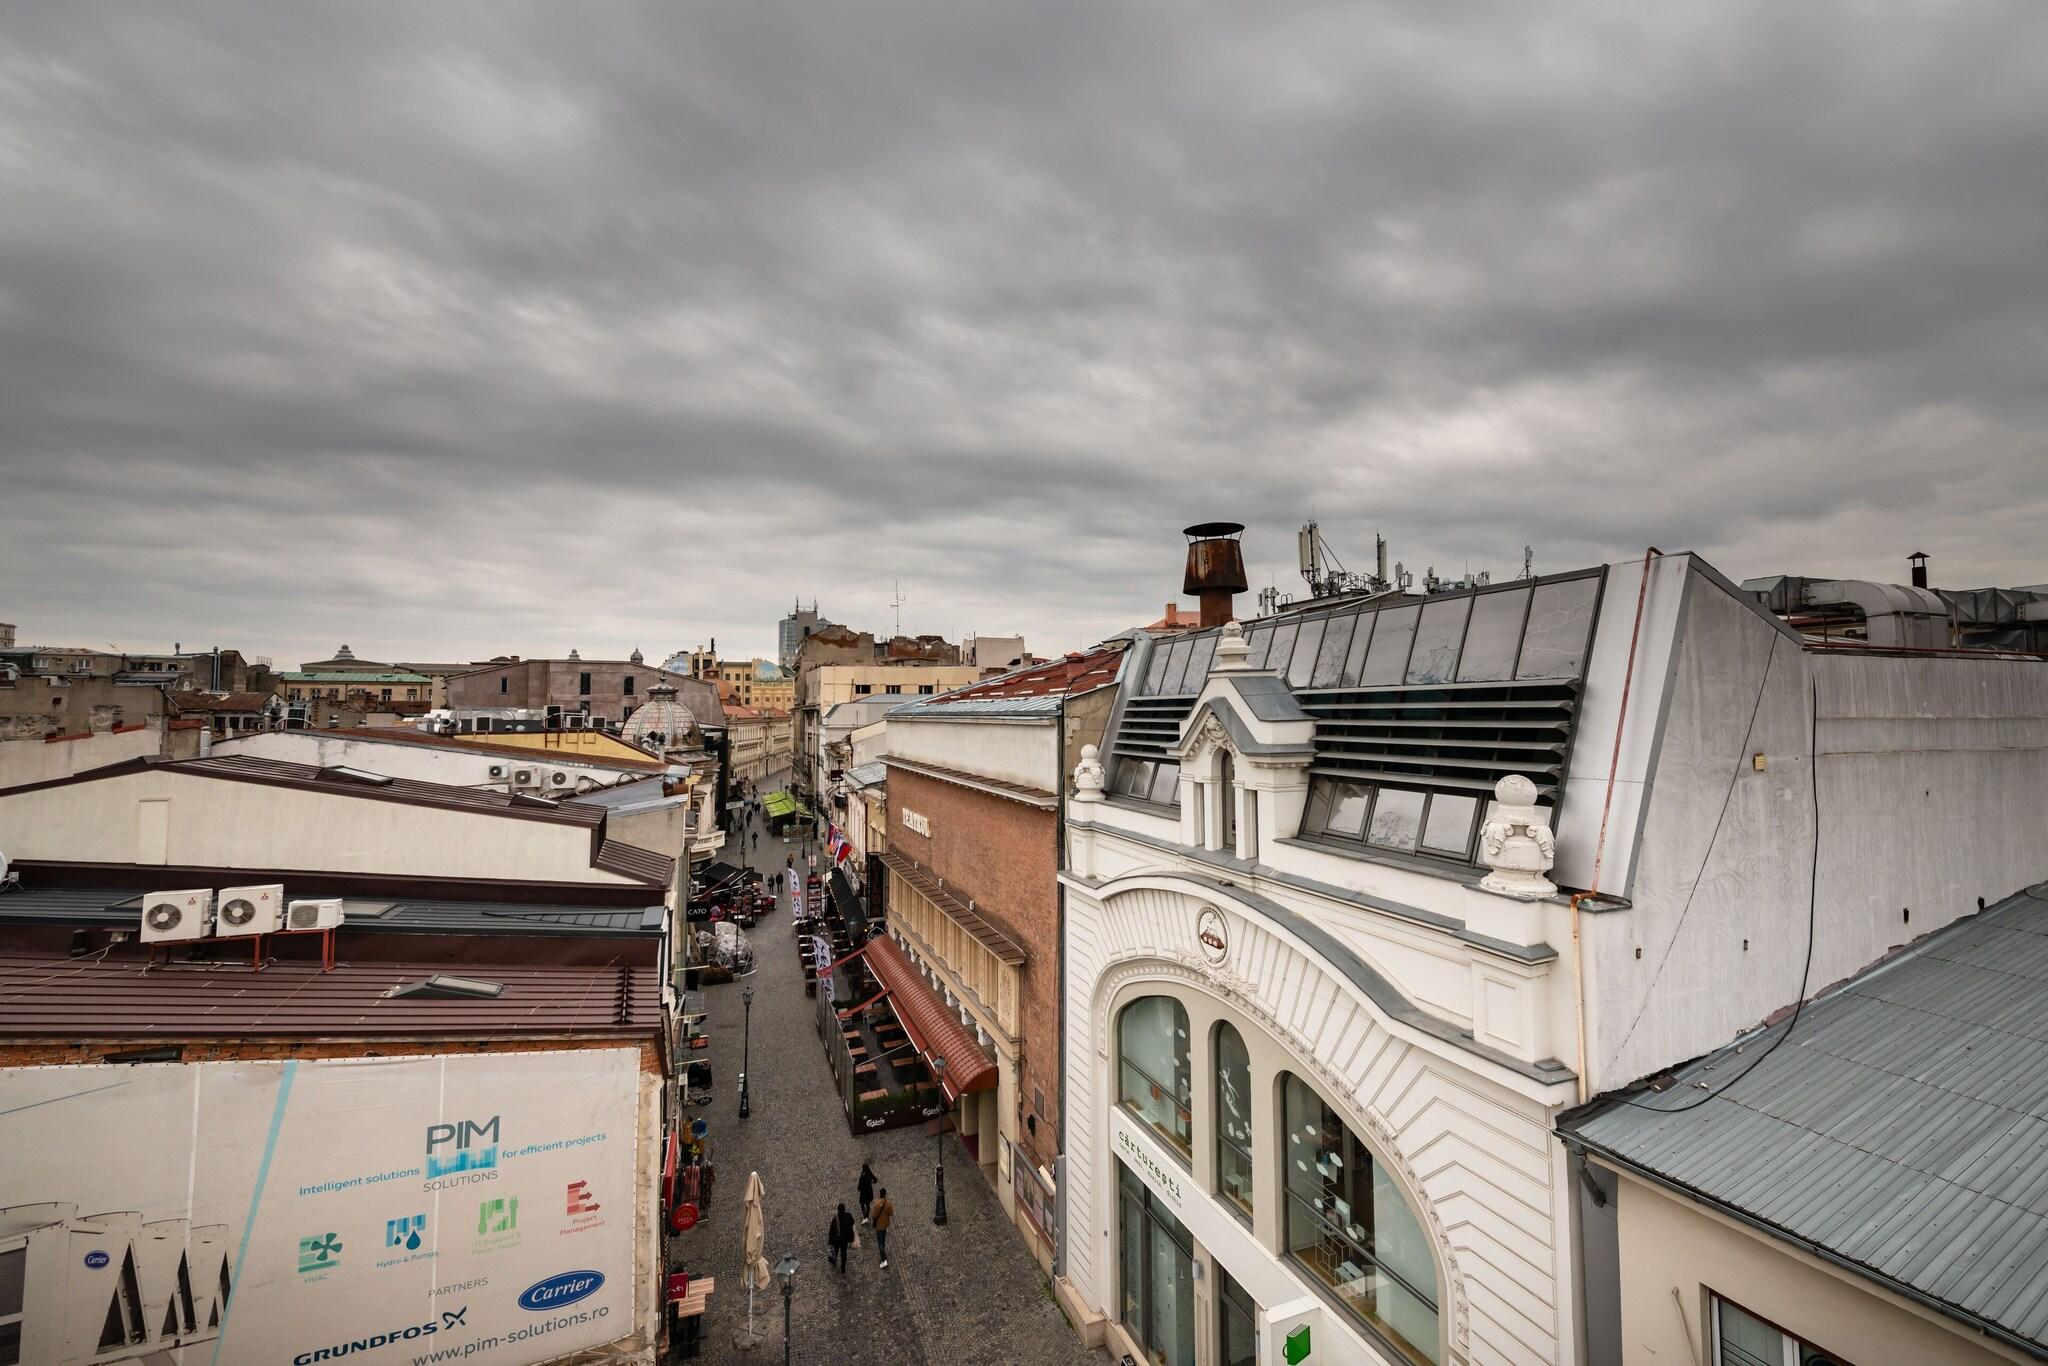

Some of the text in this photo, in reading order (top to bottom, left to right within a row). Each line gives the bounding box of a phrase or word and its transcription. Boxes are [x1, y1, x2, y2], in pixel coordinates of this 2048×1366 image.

[687, 908, 707, 916] CATO
[426, 1115, 500, 1155] PIM
[502, 1133, 607, 1159] for efficient projects
[299, 1167, 421, 1196] Intelligent solutions
[423, 1170, 498, 1193] SOLUTIONS
[560, 1220, 606, 1236] Management
[572, 1215, 597, 1225] Project
[376, 1258, 401, 1269] Hydro
[304, 1274, 329, 1284] HVAC
[428, 1277, 489, 1298] PARTNERS
[531, 1276, 594, 1303] Carrier
[293, 1321, 438, 1366] GRUNDFOS
[412, 1306, 609, 1366] www.pim-solutions.ro
